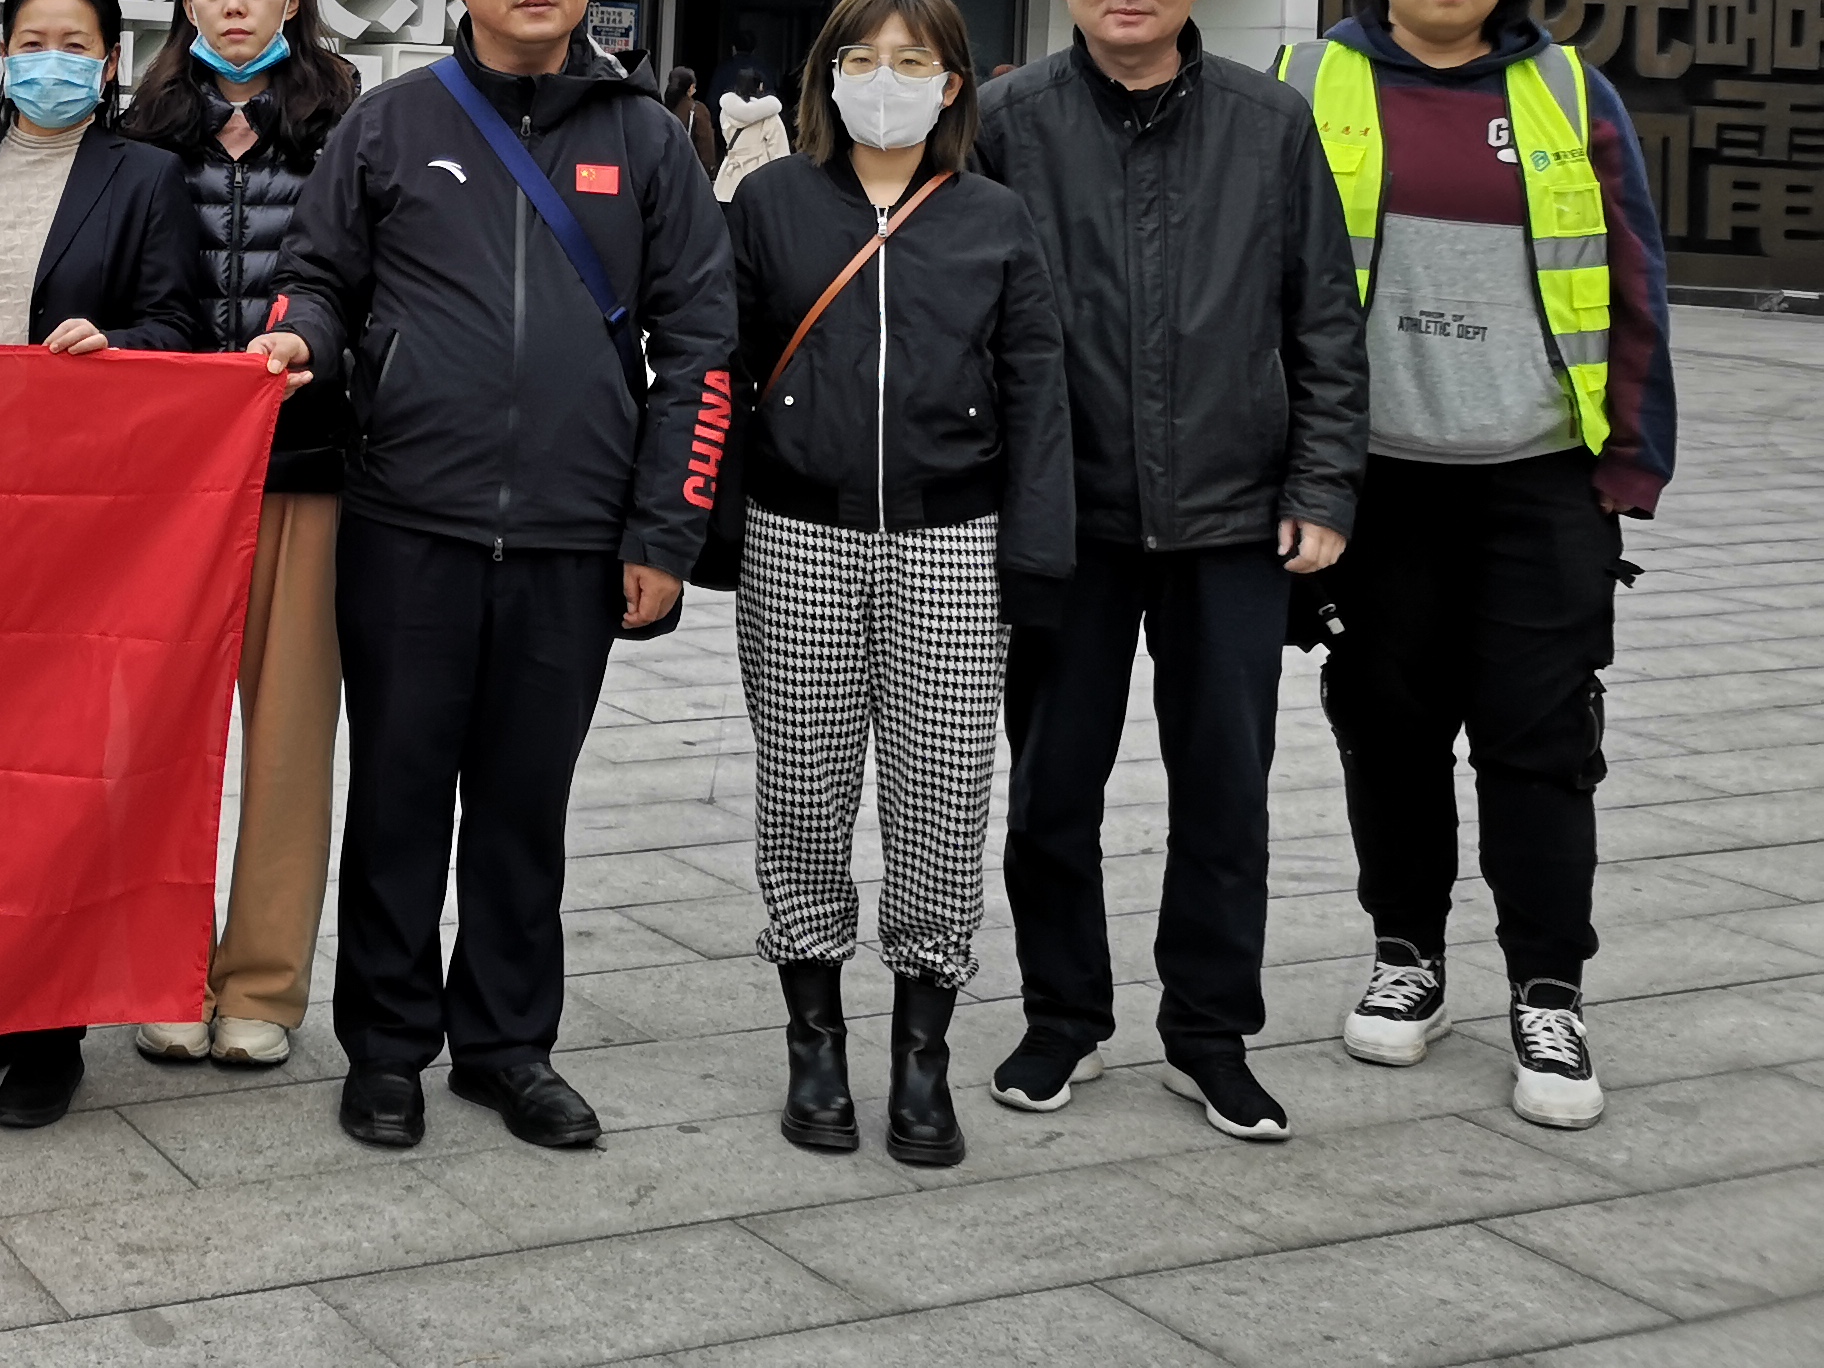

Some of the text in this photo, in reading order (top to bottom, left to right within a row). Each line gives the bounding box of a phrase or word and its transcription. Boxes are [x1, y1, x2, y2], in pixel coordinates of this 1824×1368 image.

[1487, 117, 1513, 147] G
[1456, 323, 1488, 342] DEPT
[682, 369, 733, 511] CHINA
